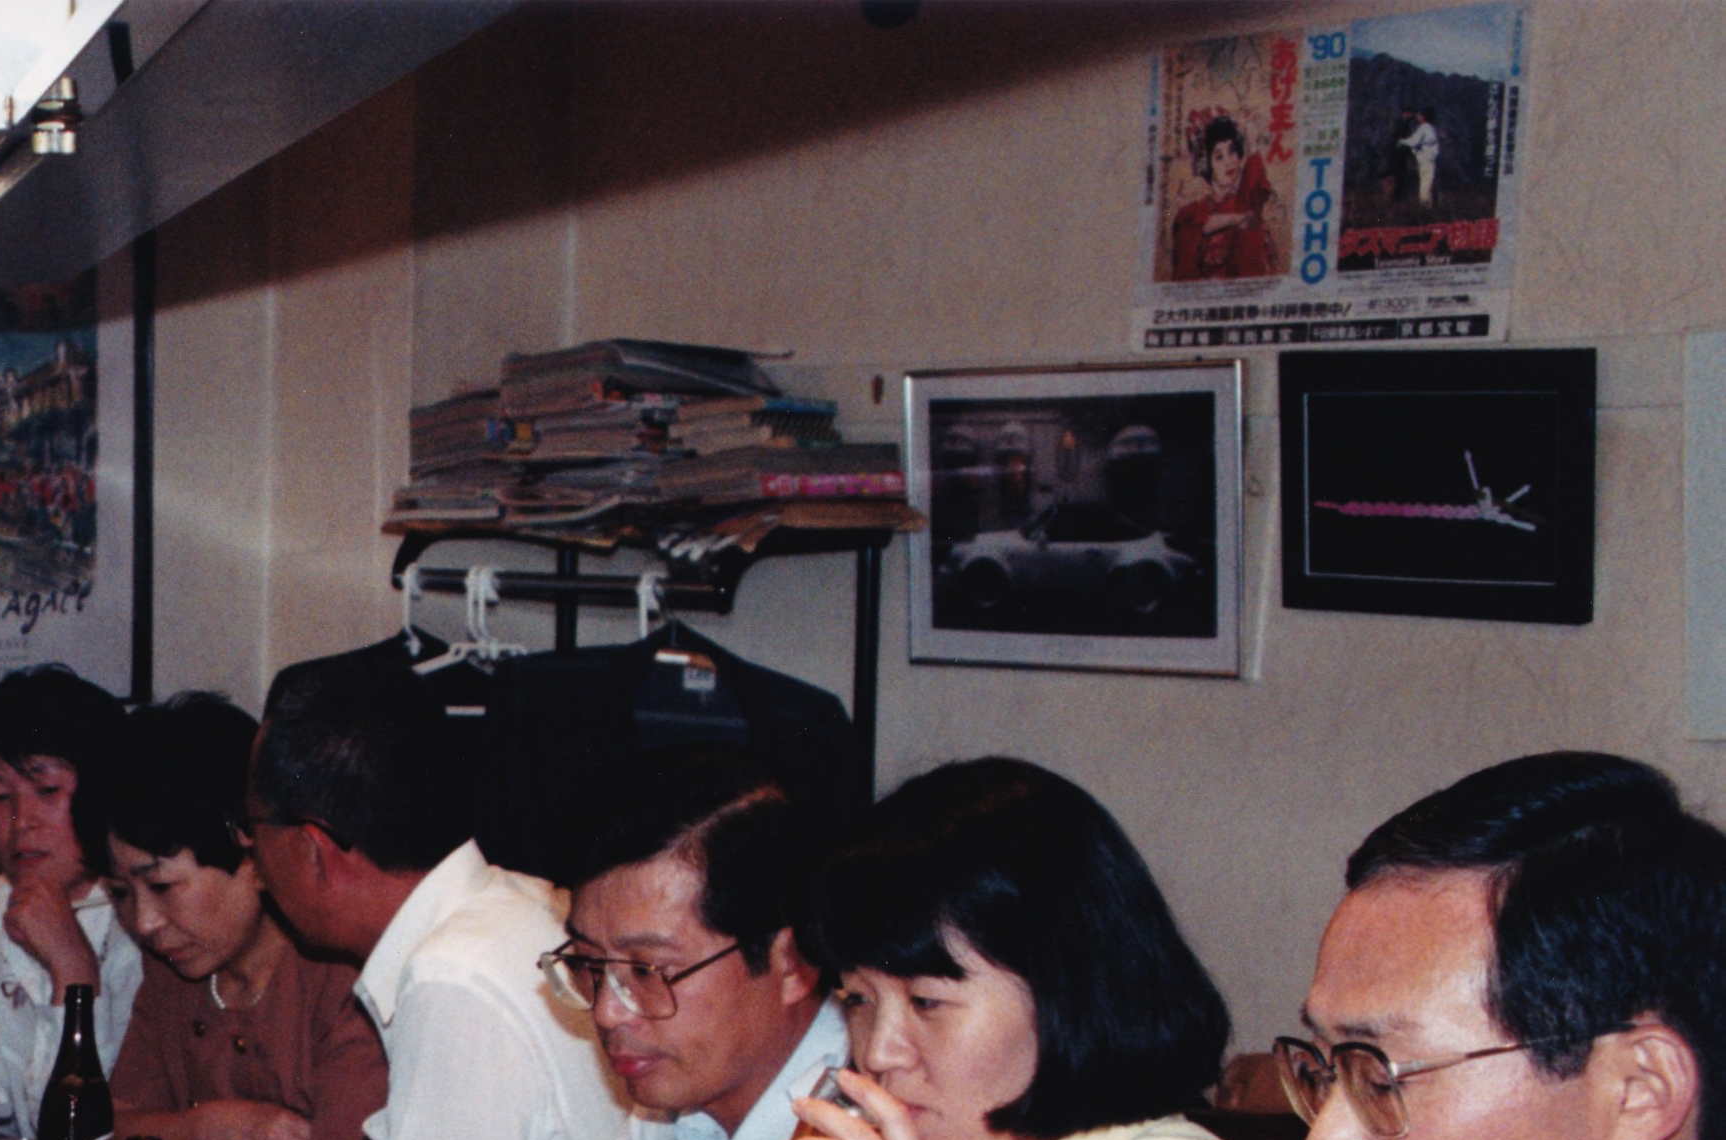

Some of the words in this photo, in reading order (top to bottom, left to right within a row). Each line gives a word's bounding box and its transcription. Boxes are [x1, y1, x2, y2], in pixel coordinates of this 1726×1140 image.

[1308, 31, 1345, 61] '90
[1266, 37, 1298, 163] あげまん
[1300, 157, 1332, 284] TOHO
[1338, 217, 1500, 258] タスマニア物語
